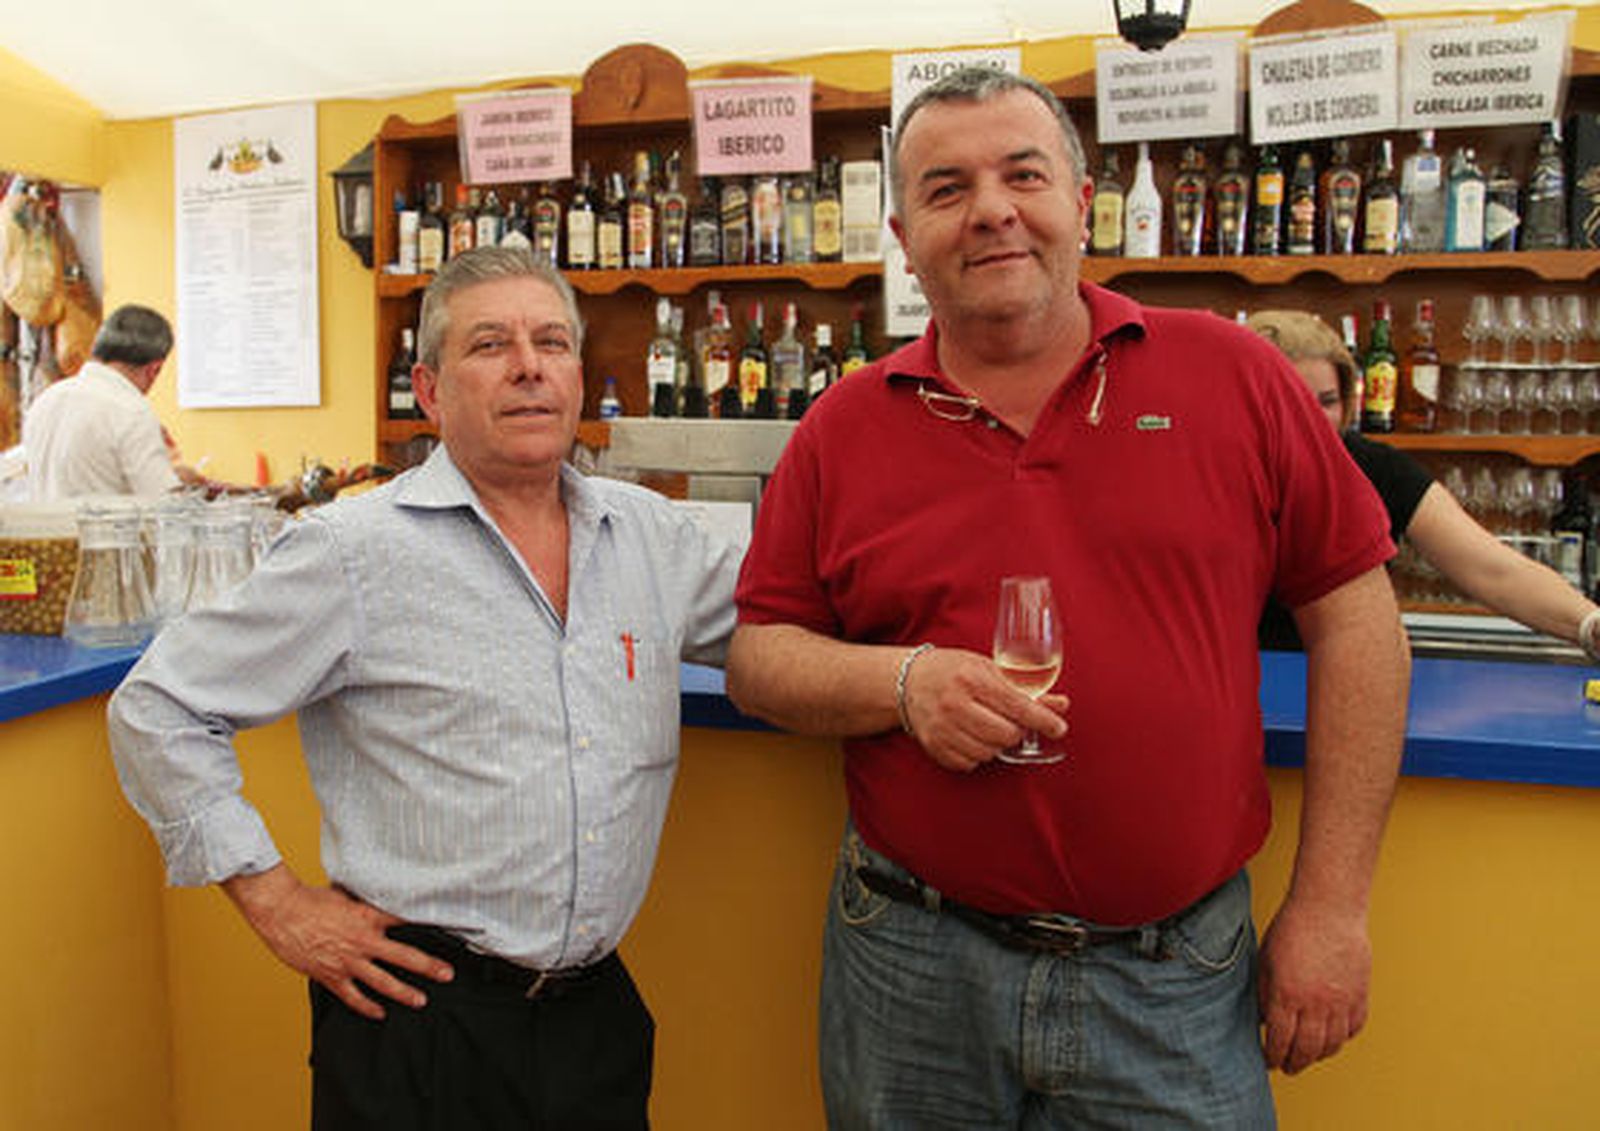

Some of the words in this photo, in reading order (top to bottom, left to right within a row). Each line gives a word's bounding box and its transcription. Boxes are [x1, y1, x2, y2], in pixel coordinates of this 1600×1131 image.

[1429, 41, 1472, 59] CARNE
[1476, 37, 1538, 56] MECHADA
[1262, 57, 1315, 84] CHULETAS
[1317, 54, 1330, 79] DE
[1431, 65, 1532, 87] CHICHARRONES
[703, 96, 796, 121] LAGARTITO
[1314, 98, 1328, 123] DE
[1330, 93, 1380, 120] CORDERO
[1413, 95, 1489, 115] CARRILLADA
[1491, 93, 1544, 111] IBERICA
[717, 133, 785, 157] IBERICO
